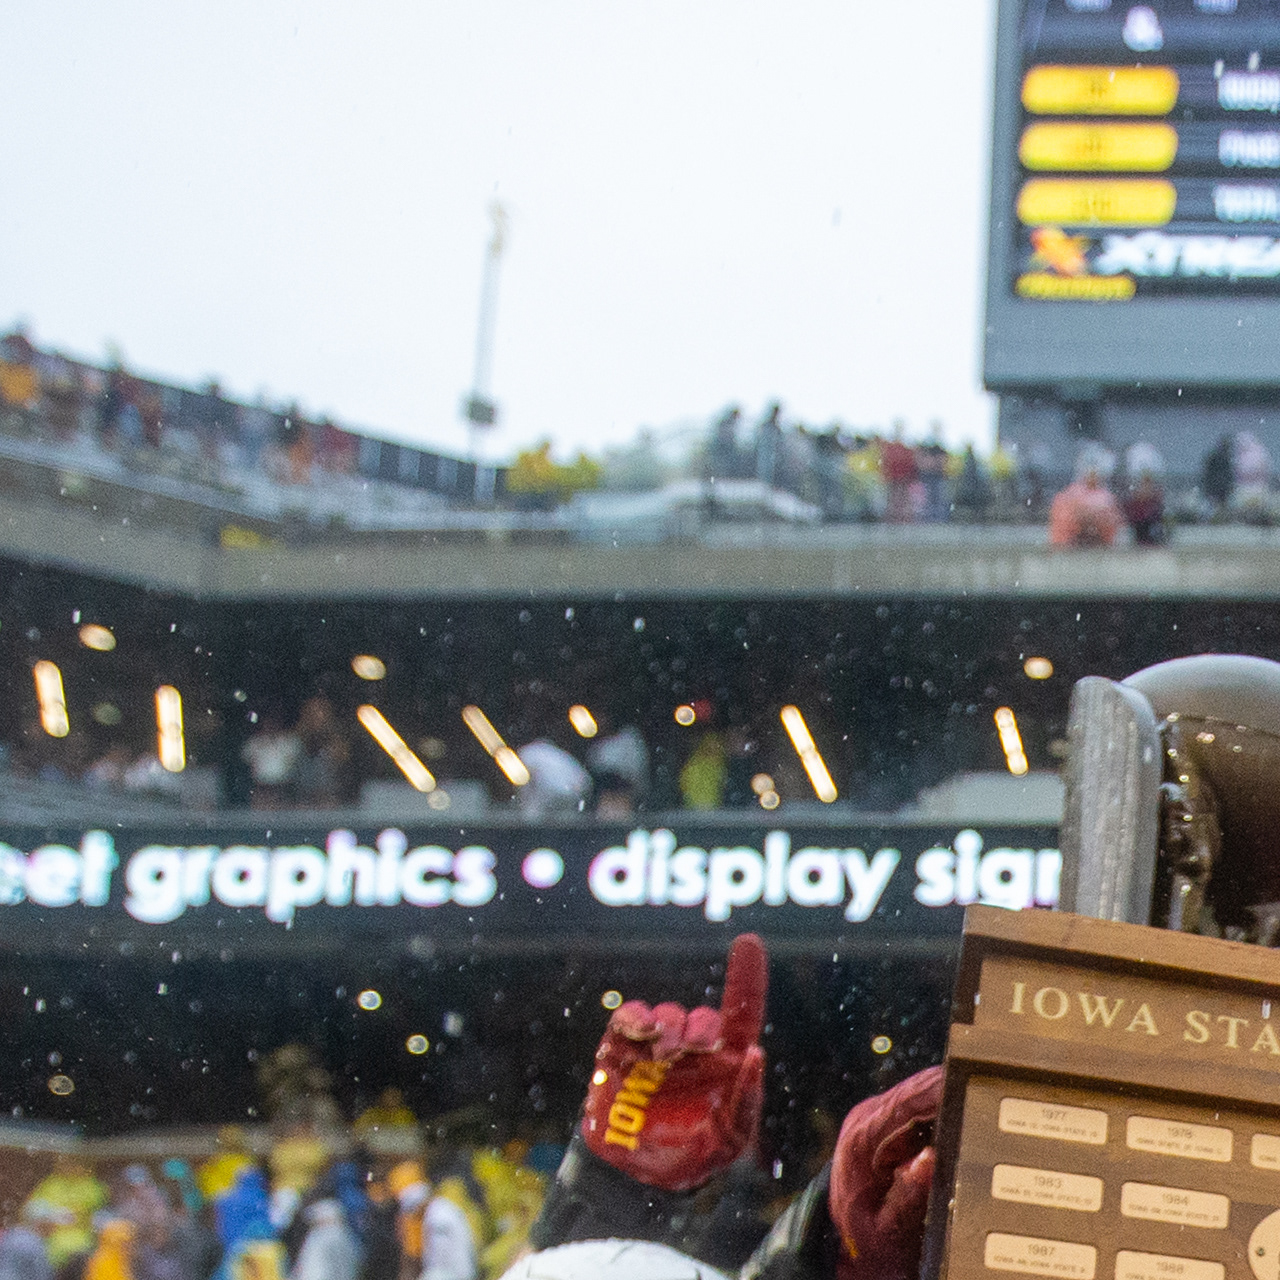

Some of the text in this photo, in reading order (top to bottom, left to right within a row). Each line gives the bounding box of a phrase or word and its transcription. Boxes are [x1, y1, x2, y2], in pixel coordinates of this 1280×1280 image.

[124, 829, 498, 924] graphics
[588, 829, 901, 920] display
[1009, 981, 1159, 1036] IOWA
[1027, 1243, 1056, 1258] 1987
